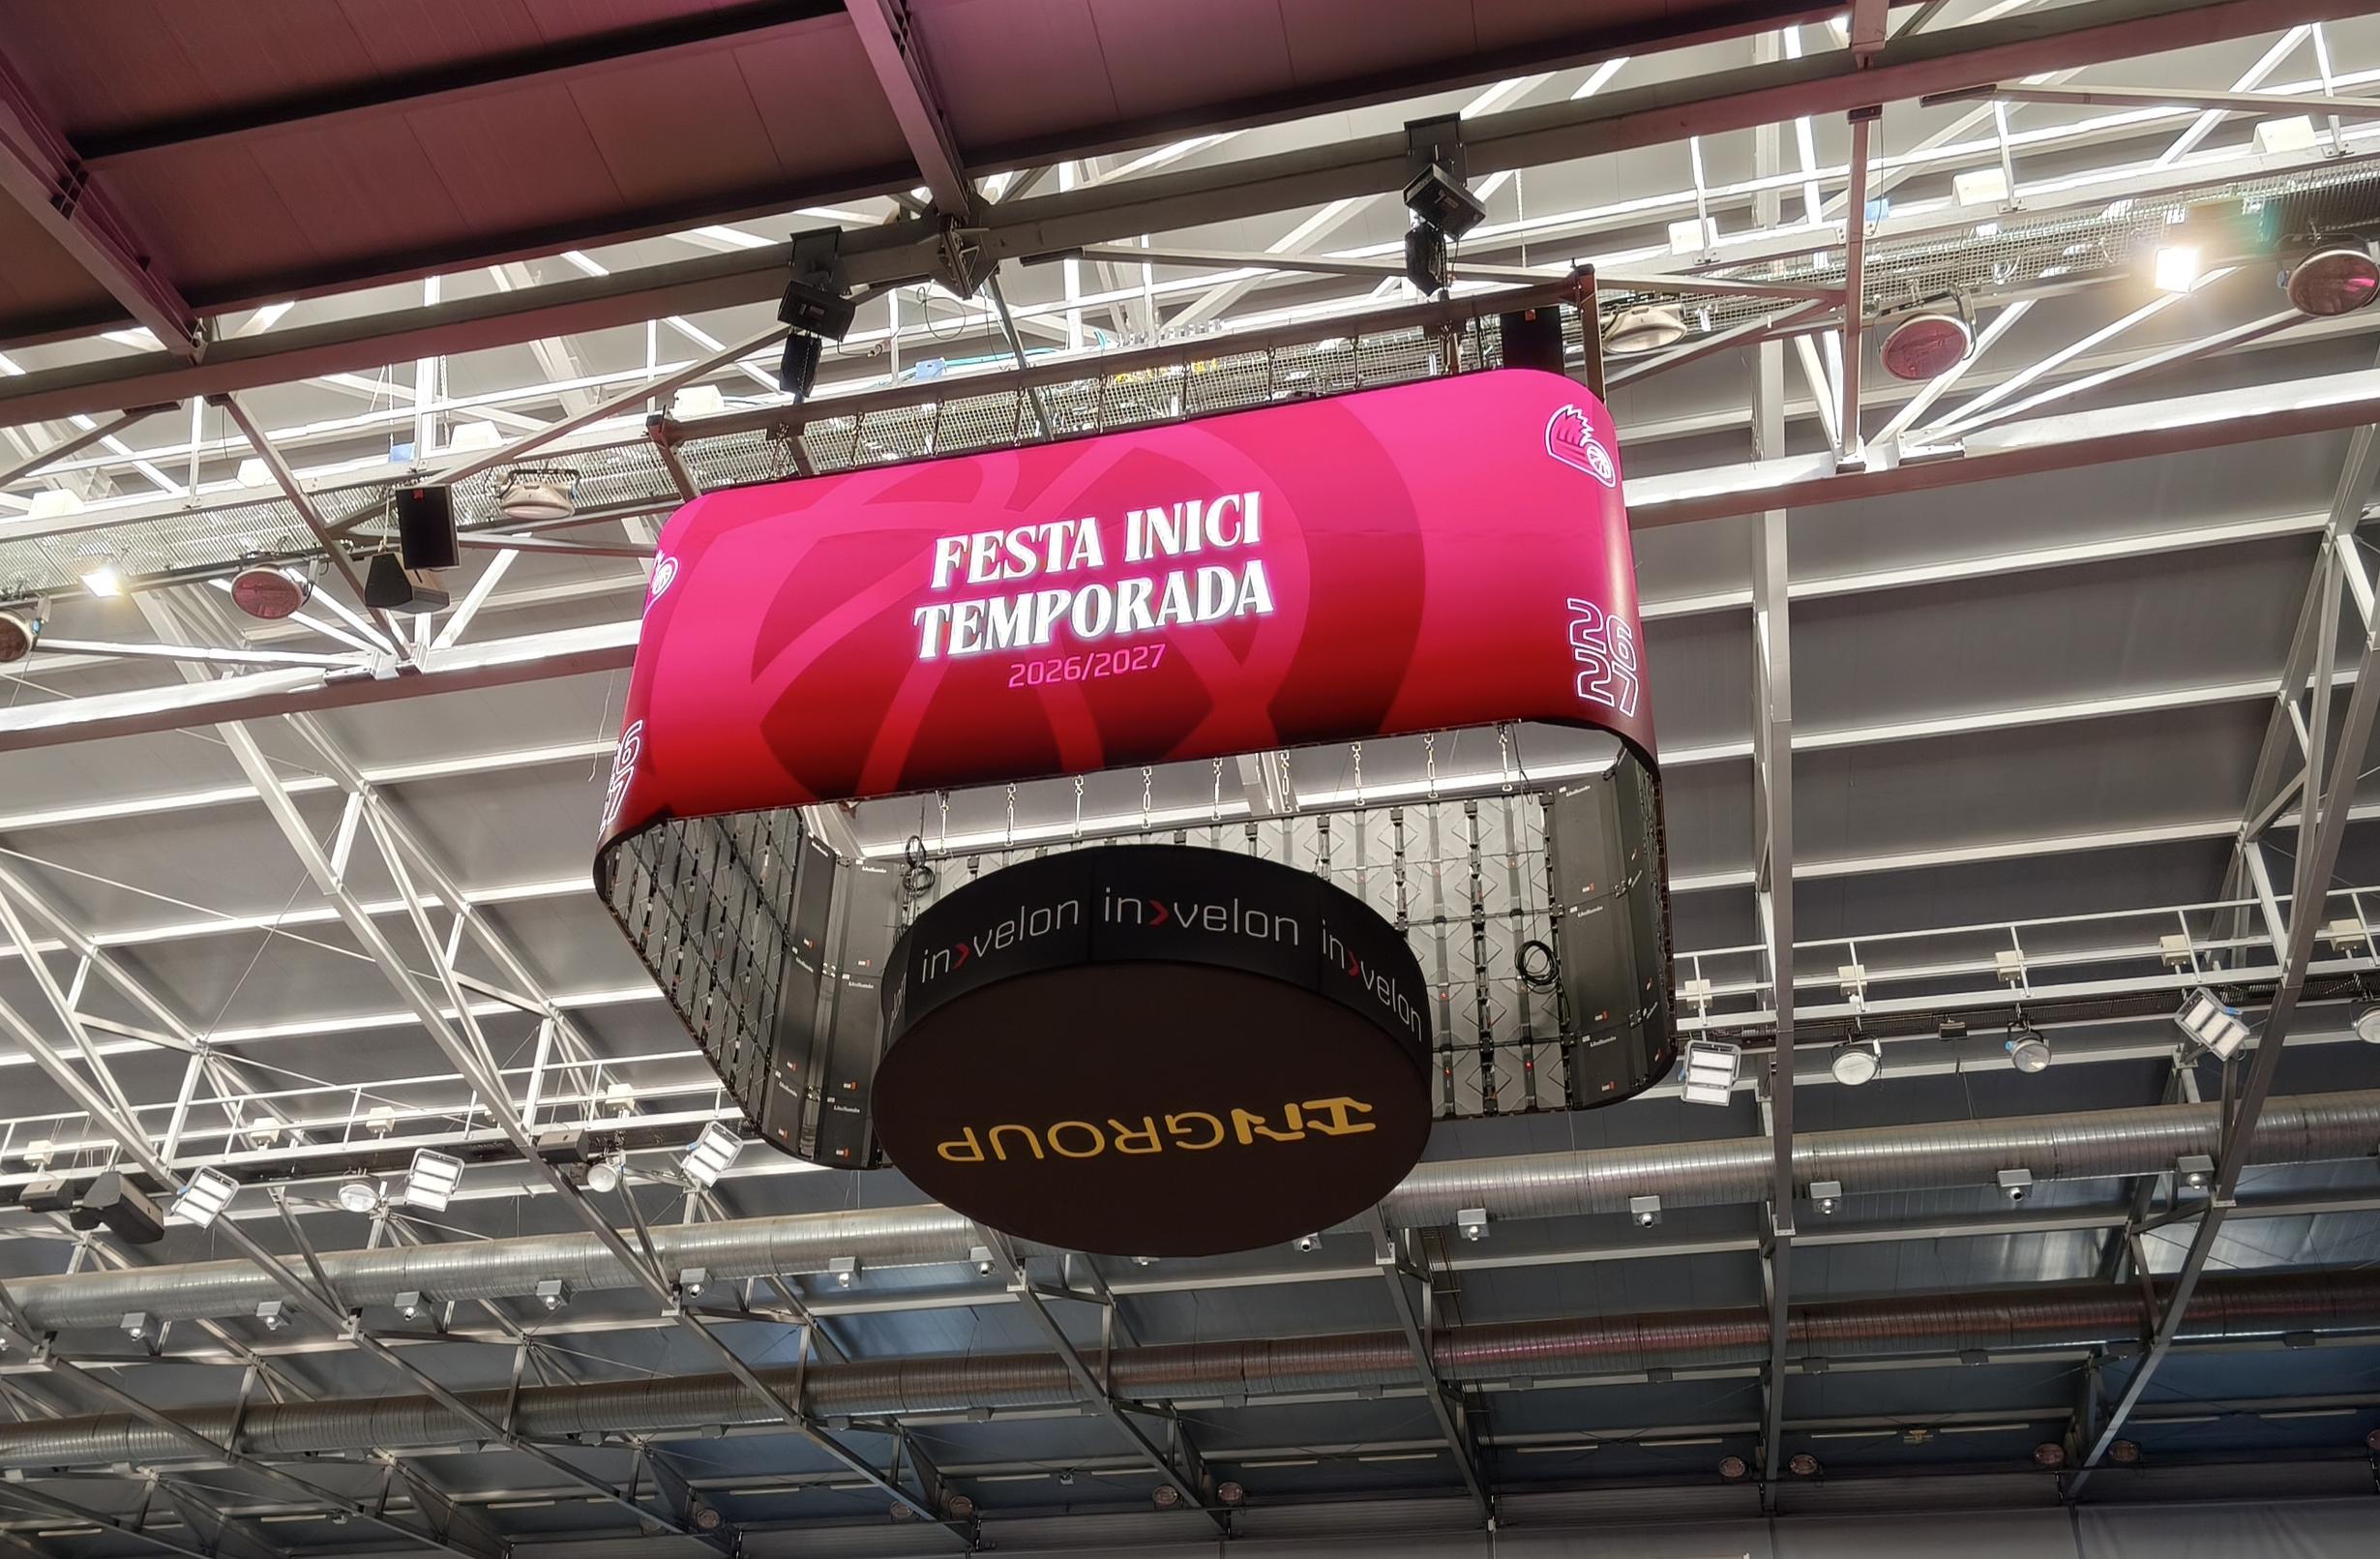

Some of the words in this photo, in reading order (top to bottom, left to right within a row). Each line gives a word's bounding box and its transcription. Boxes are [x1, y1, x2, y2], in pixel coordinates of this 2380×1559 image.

[930, 517, 1104, 589] FESTA
[1123, 491, 1262, 562] INICI
[913, 559, 1274, 659] TEMPORADA
[1008, 644, 1167, 688] 2026/2027
